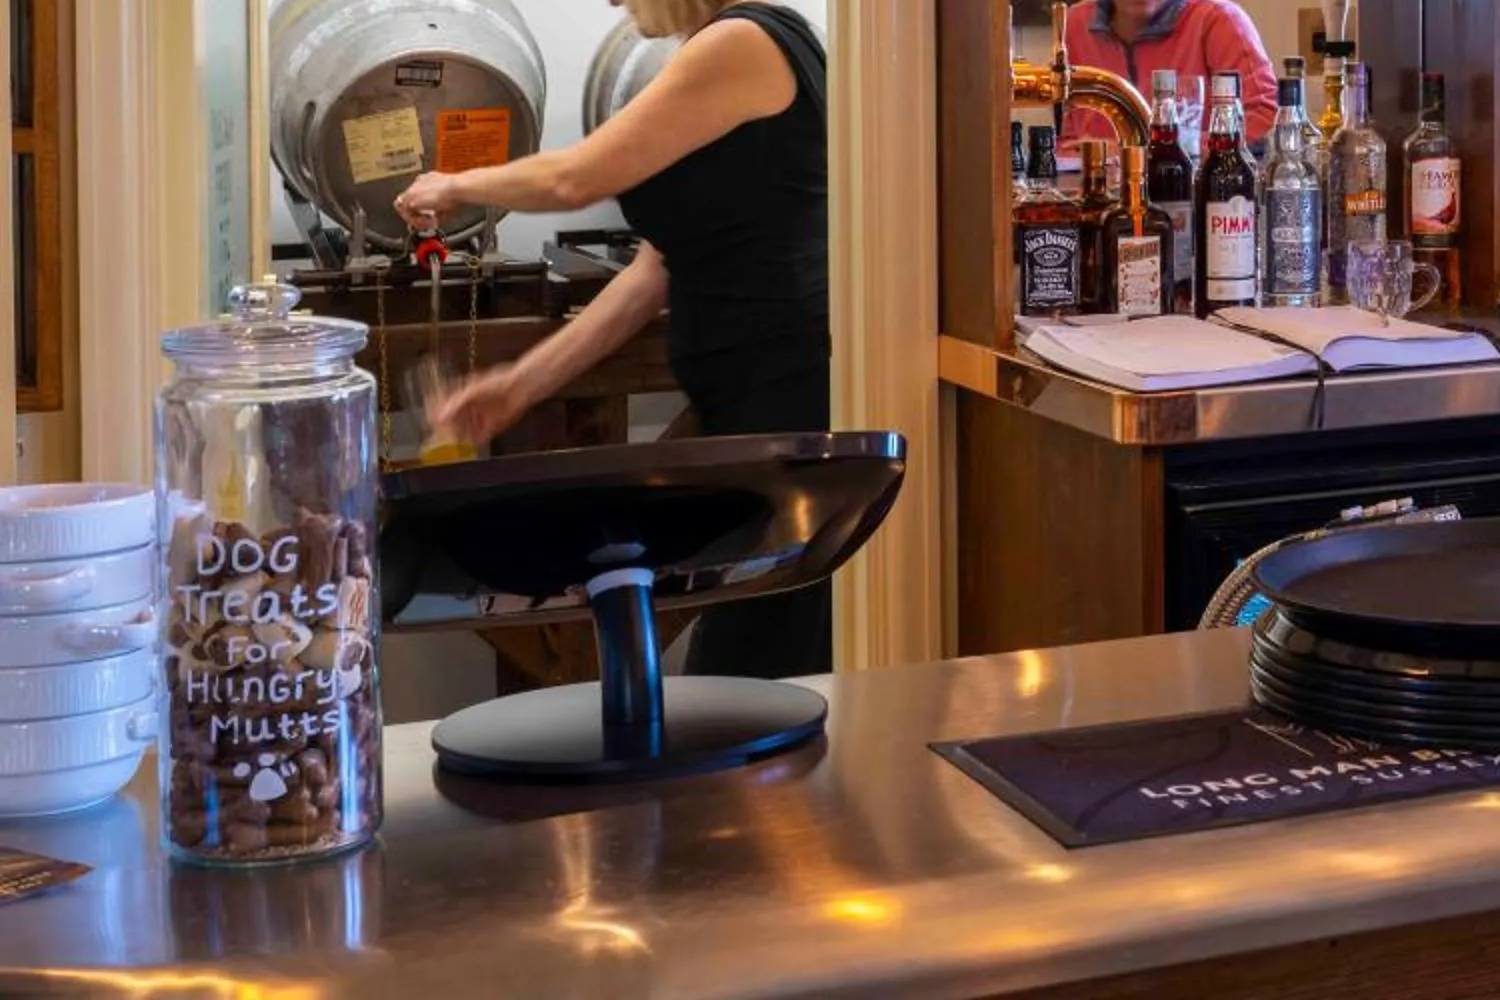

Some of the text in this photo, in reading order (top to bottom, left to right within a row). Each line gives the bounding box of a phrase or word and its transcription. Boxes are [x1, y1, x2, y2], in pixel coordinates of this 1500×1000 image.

[196, 535, 299, 576] DOG
[176, 582, 340, 626] Treats
[209, 708, 342, 745] Mutts
[1140, 772, 1278, 800] LONG
[1288, 752, 1402, 781] MAN
[1171, 779, 1325, 809] FINEST
